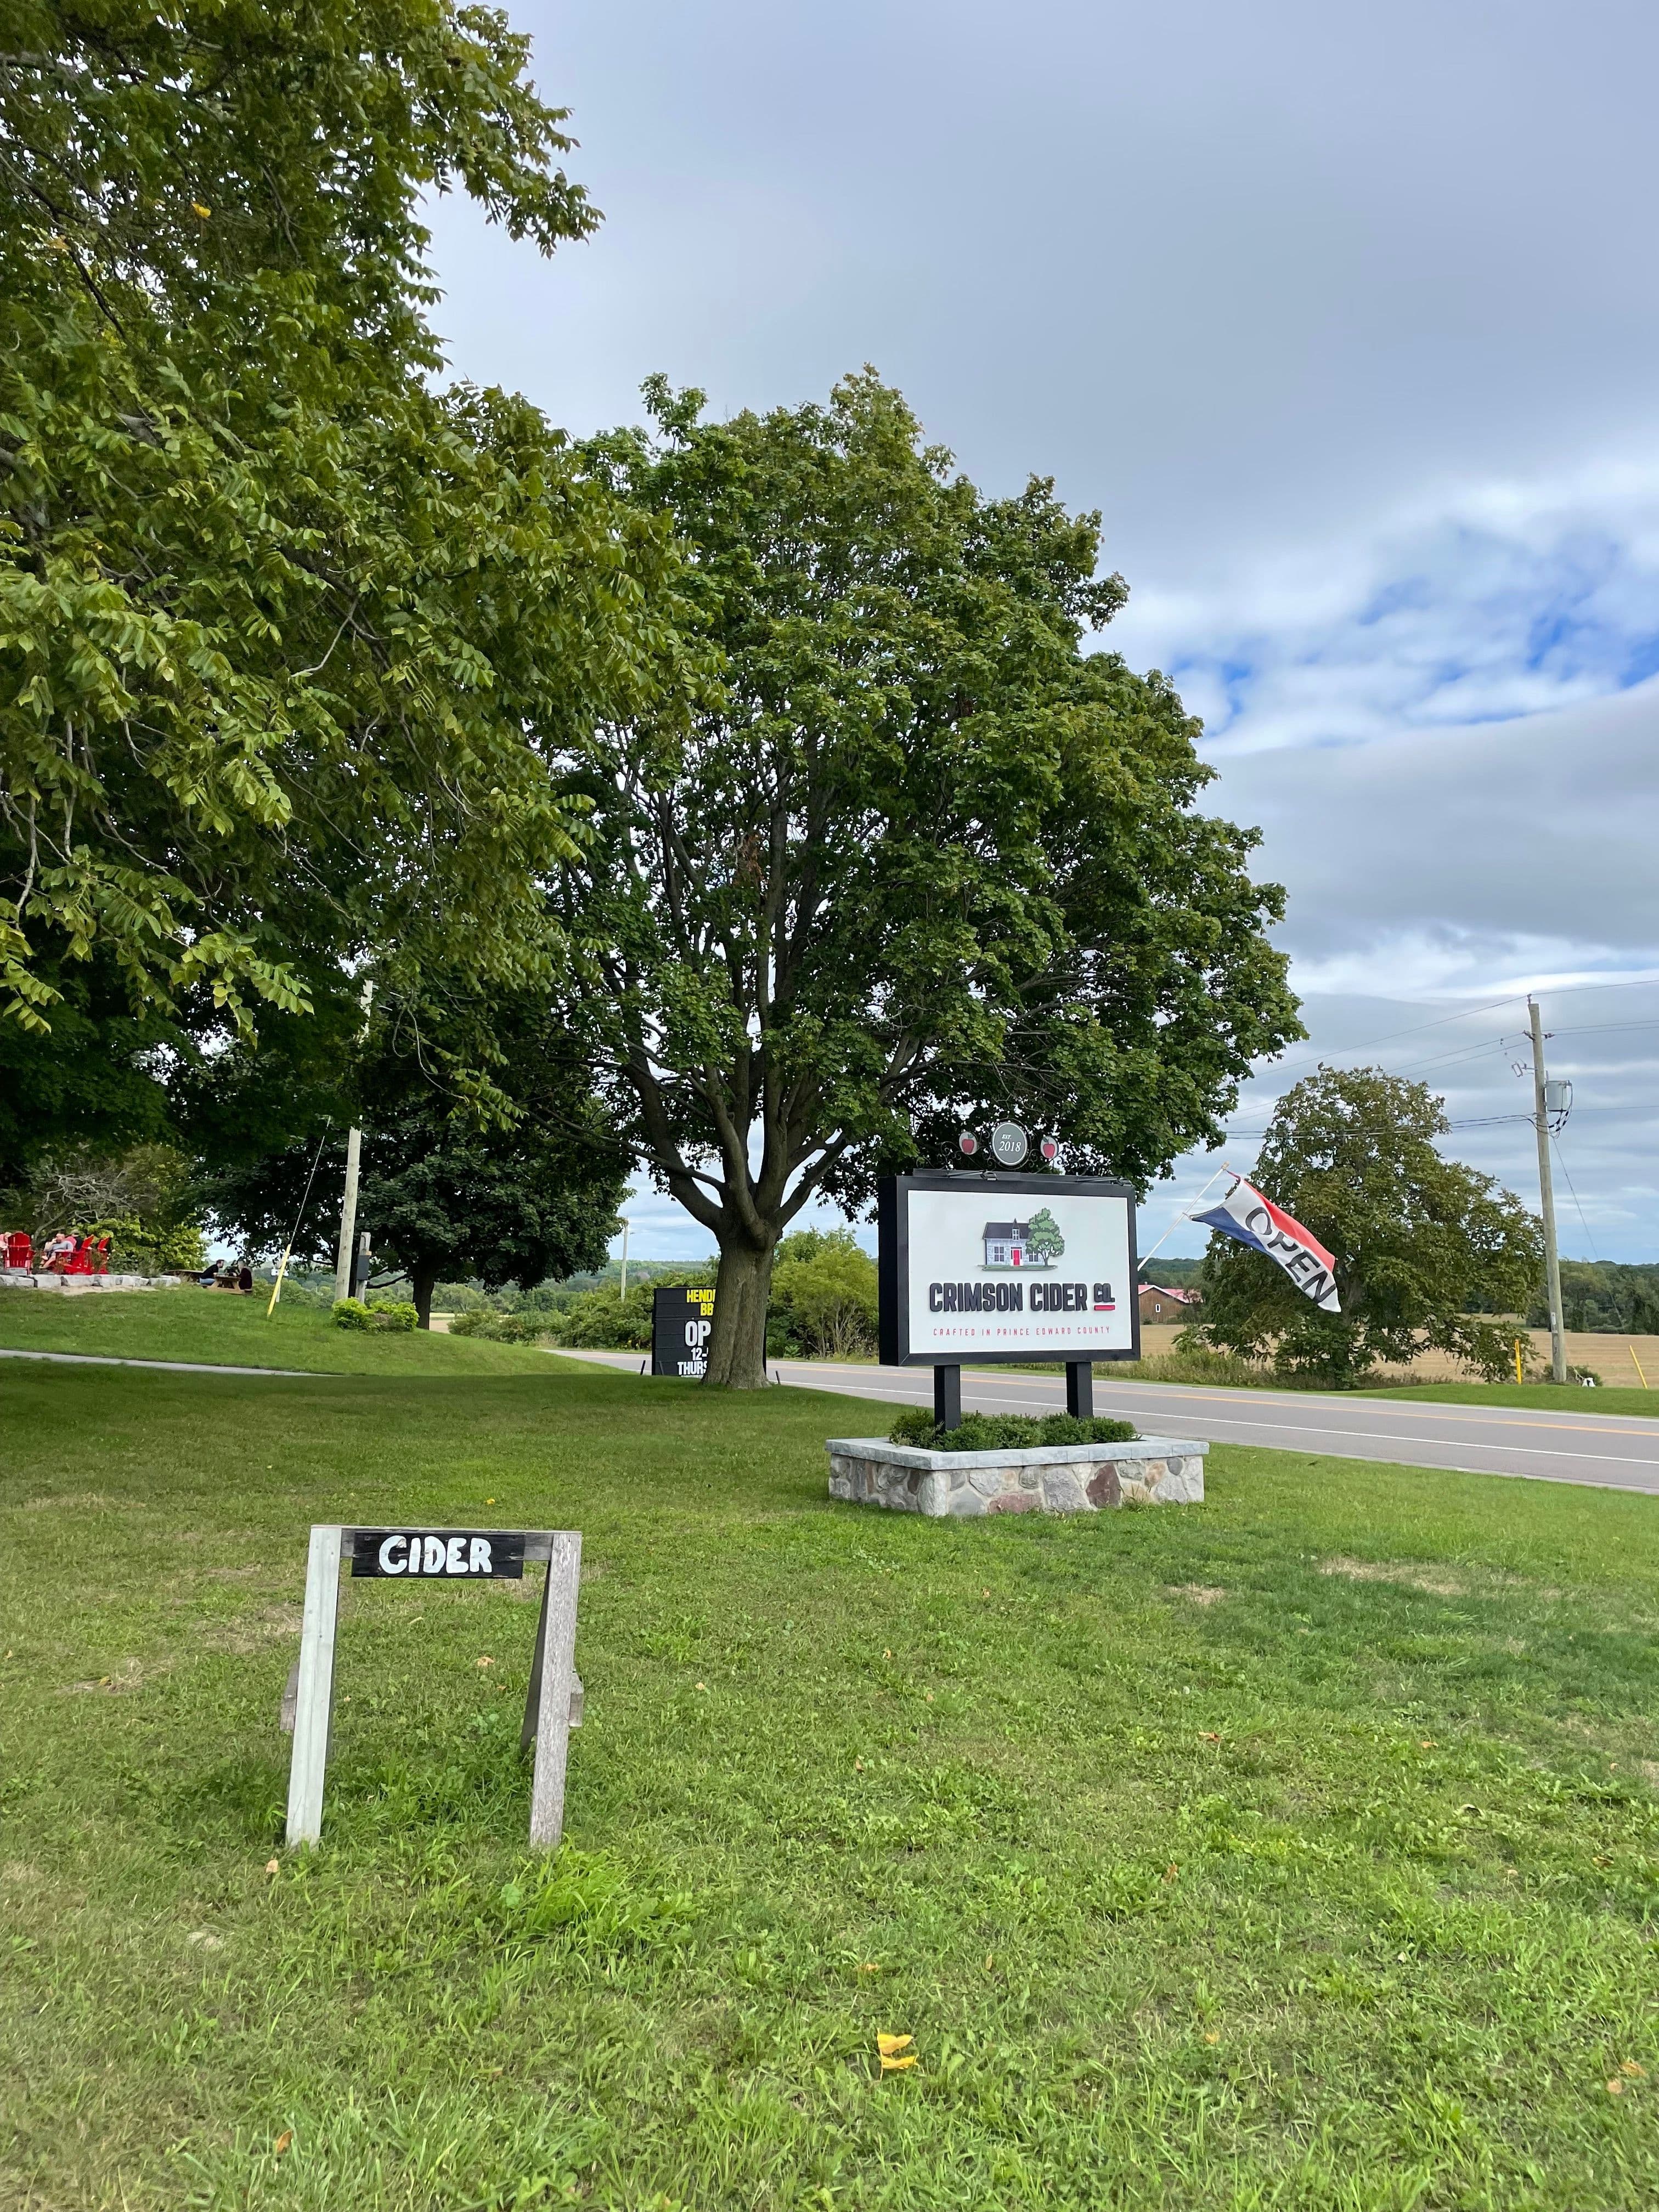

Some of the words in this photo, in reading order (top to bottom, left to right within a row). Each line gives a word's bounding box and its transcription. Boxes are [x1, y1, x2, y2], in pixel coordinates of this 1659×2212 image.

[998, 1141, 1022, 1152] 2018
[1245, 1206, 1336, 1303] OPEN
[929, 1282, 1023, 1312] CRIMSON
[1030, 1283, 1087, 1312] CIDER
[1093, 1283, 1115, 1303] CO.
[997, 1328, 1029, 1336] PRINCE
[1036, 1327, 1071, 1335] EDWARD
[1077, 1326, 1110, 1334] COUNTY
[691, 1347, 709, 1361] 12-
[379, 1535, 493, 1574] CIDER
